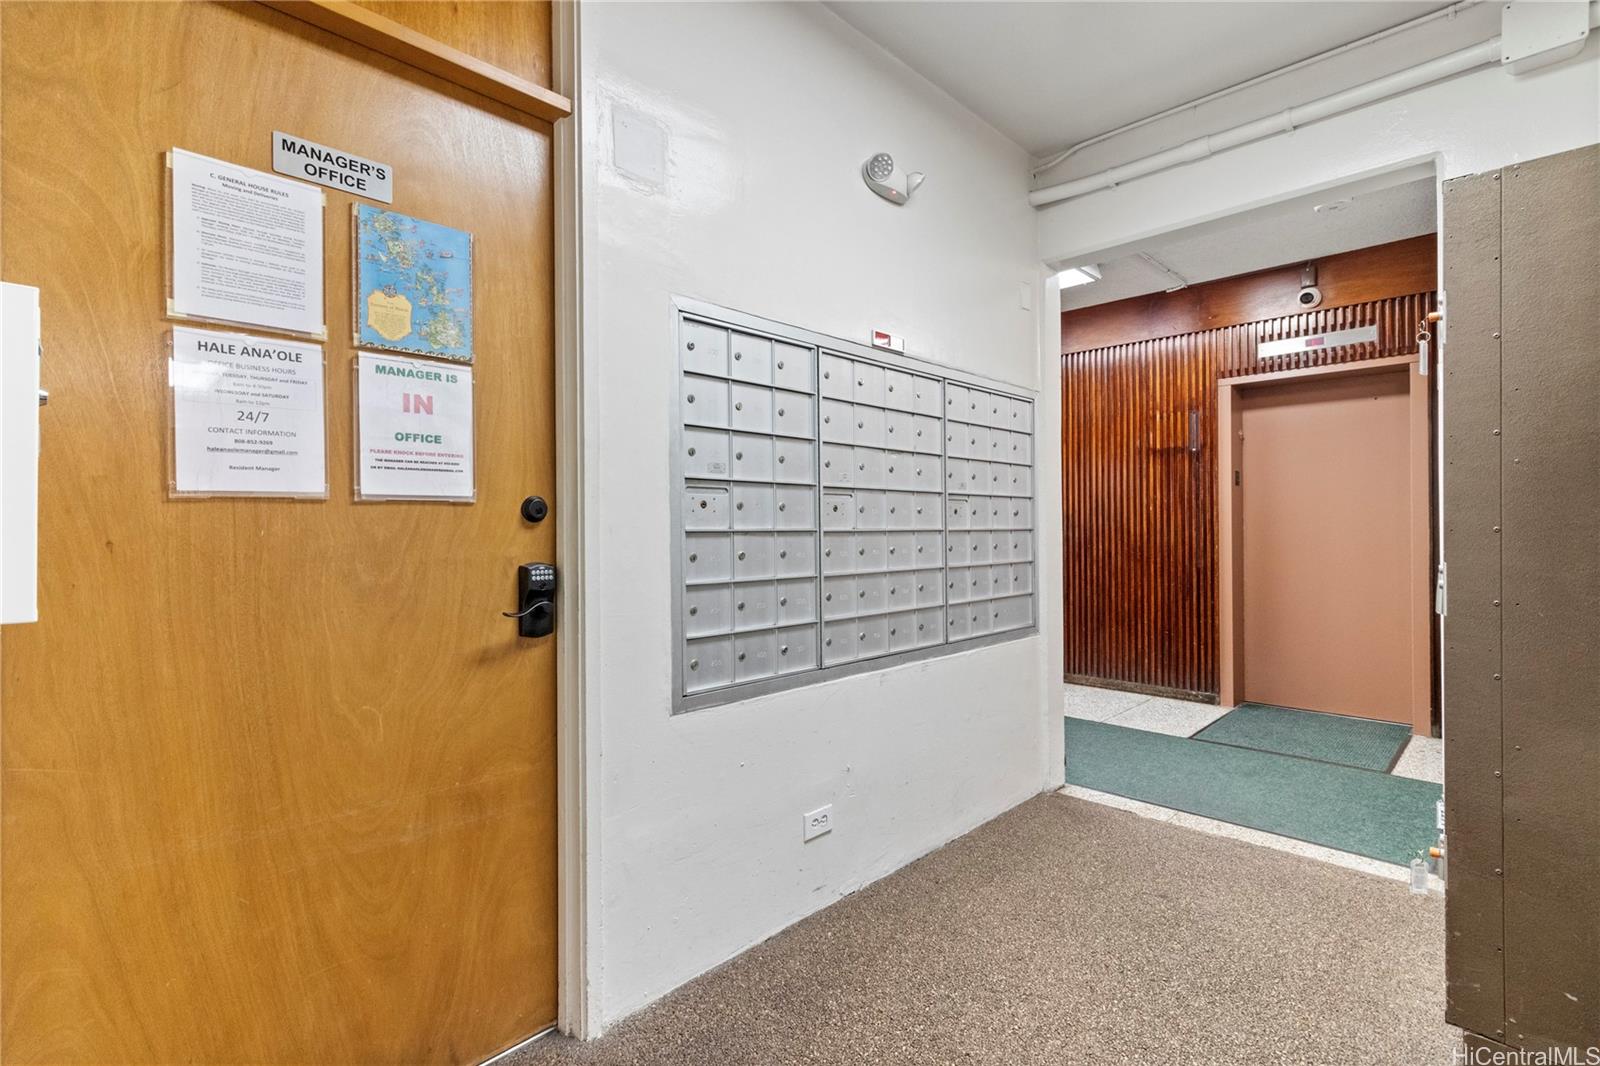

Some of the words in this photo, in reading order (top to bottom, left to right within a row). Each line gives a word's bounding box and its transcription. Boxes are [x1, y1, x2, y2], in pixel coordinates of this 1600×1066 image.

[282, 138, 387, 181] MANAGER'S
[304, 163, 367, 191] OFFICE
[209, 172, 217, 180] C.
[218, 175, 247, 188] GENERAL
[247, 183, 269, 193] HOUSE
[271, 188, 289, 198] RULES
[222, 183, 242, 193] Moving
[197, 340, 236, 355] HALE
[235, 363, 270, 373] BUSINESS
[272, 368, 296, 376] HOURS
[375, 364, 442, 382] MANAGER
[446, 374, 458, 384] IS
[402, 392, 434, 415] IN
[236, 410, 270, 424] 24/7
[207, 426, 243, 435] CONTACT
[245, 429, 297, 438] INFORMATION
[394, 432, 443, 444] OFFICE
[255, 465, 280, 473] Manager
